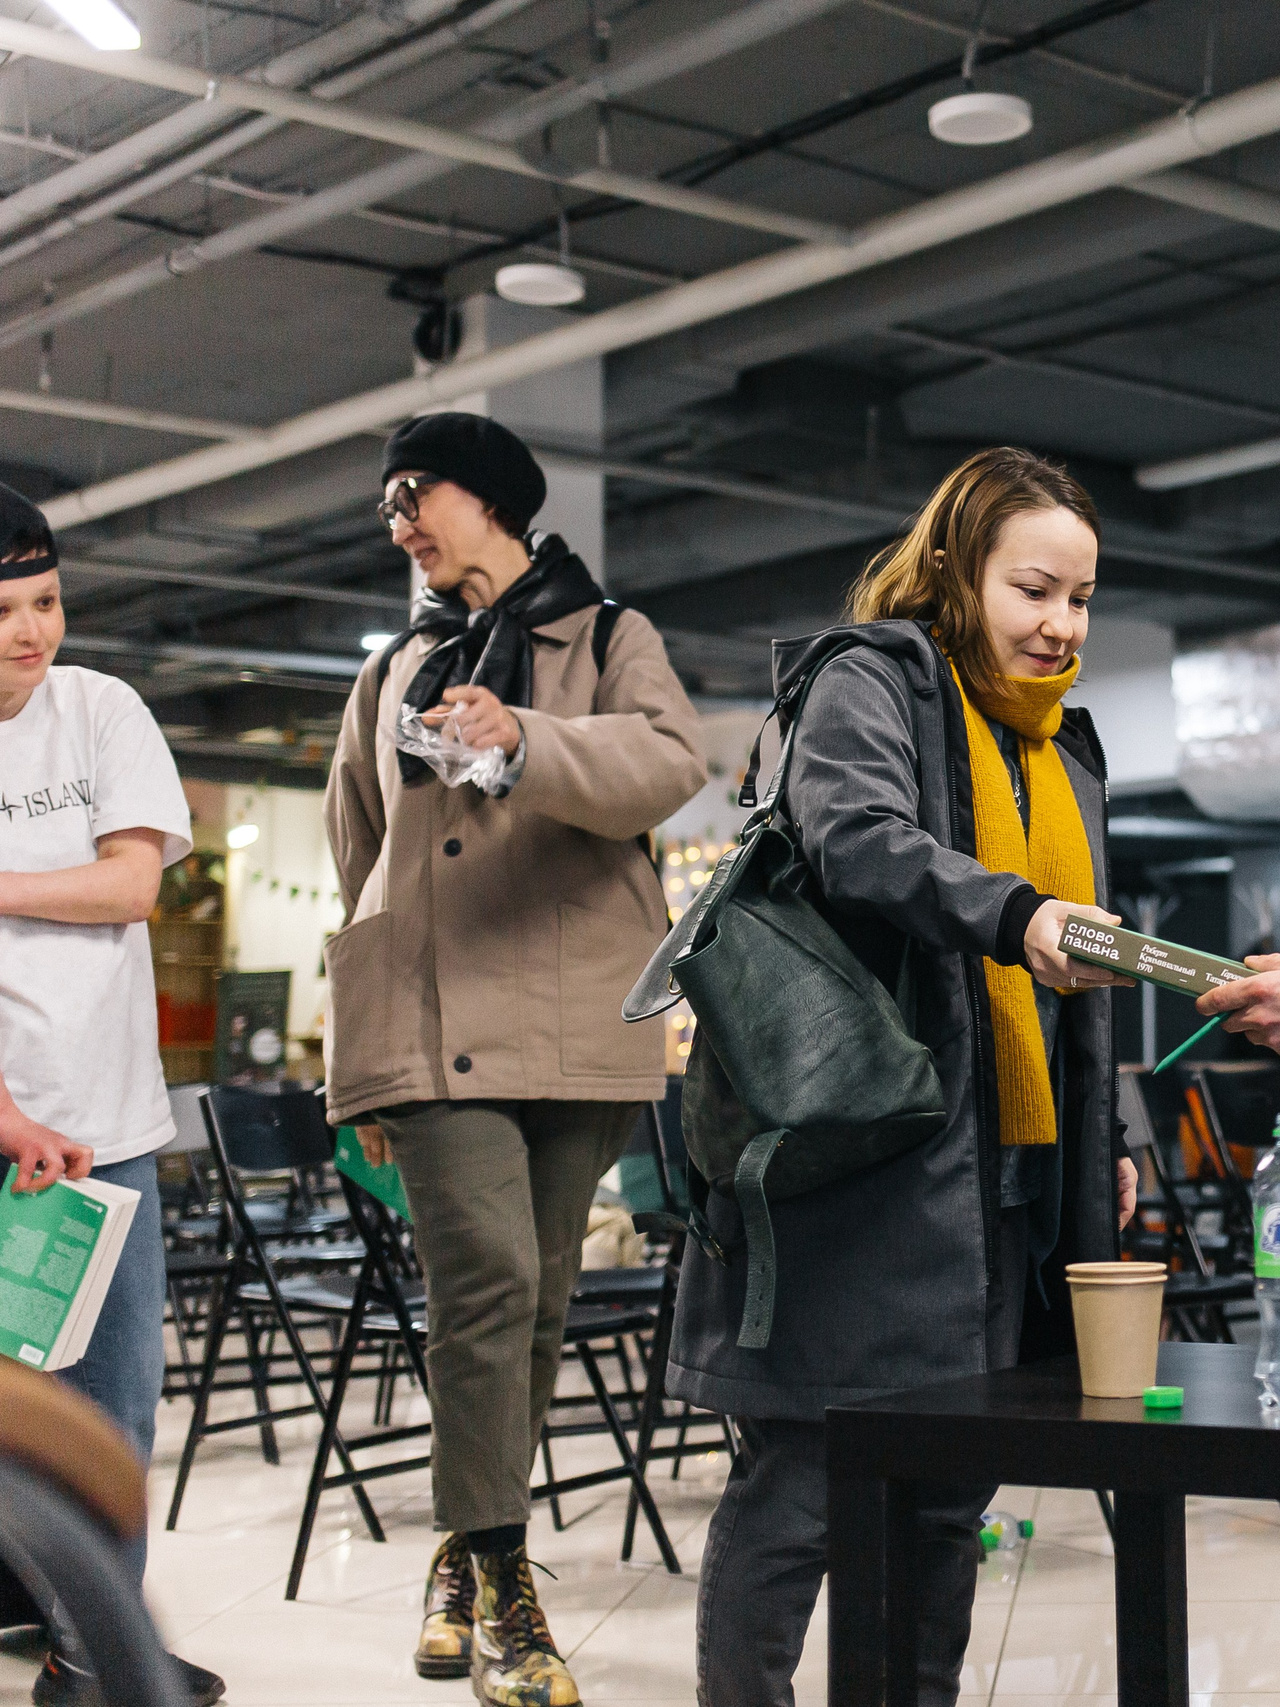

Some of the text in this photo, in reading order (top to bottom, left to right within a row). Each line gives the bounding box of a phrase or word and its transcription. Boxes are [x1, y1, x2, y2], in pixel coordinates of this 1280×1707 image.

[1067, 922, 1115, 945] слово
[1063, 934, 1120, 961] пацана
[1141, 943, 1169, 959] Роберт
[1136, 961, 1154, 974] 1970
[1138, 952, 1197, 977] Криминальный
